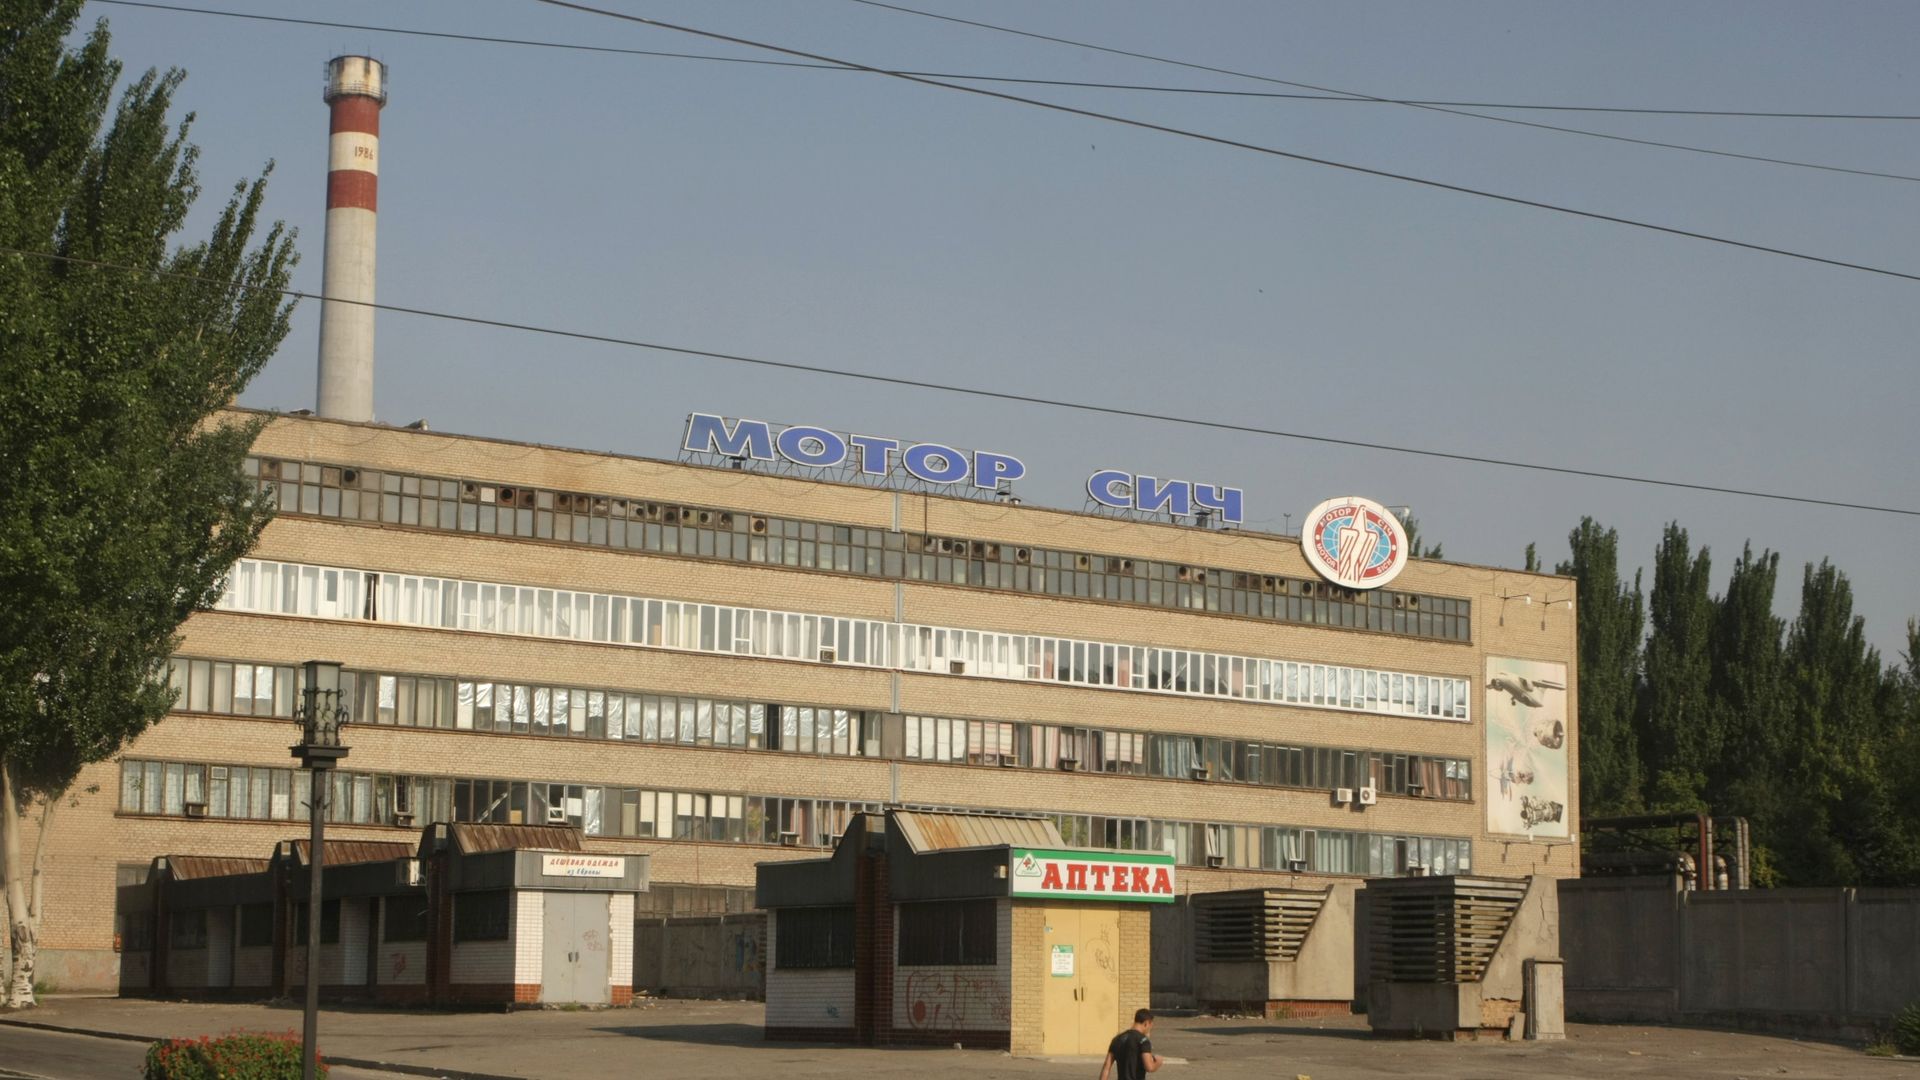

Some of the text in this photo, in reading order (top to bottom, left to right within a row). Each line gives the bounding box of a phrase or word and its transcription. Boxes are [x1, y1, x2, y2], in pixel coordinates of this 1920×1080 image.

[684, 412, 1243, 523] МОТОР СИЧ
[1320, 507, 1352, 527] МОТОР
[1316, 543, 1392, 574] MOTOR SICH
[550, 858, 619, 867] ДЕШЕВАЯ ОДЕЖДА
[1041, 862, 1173, 894] АПТЕКА
